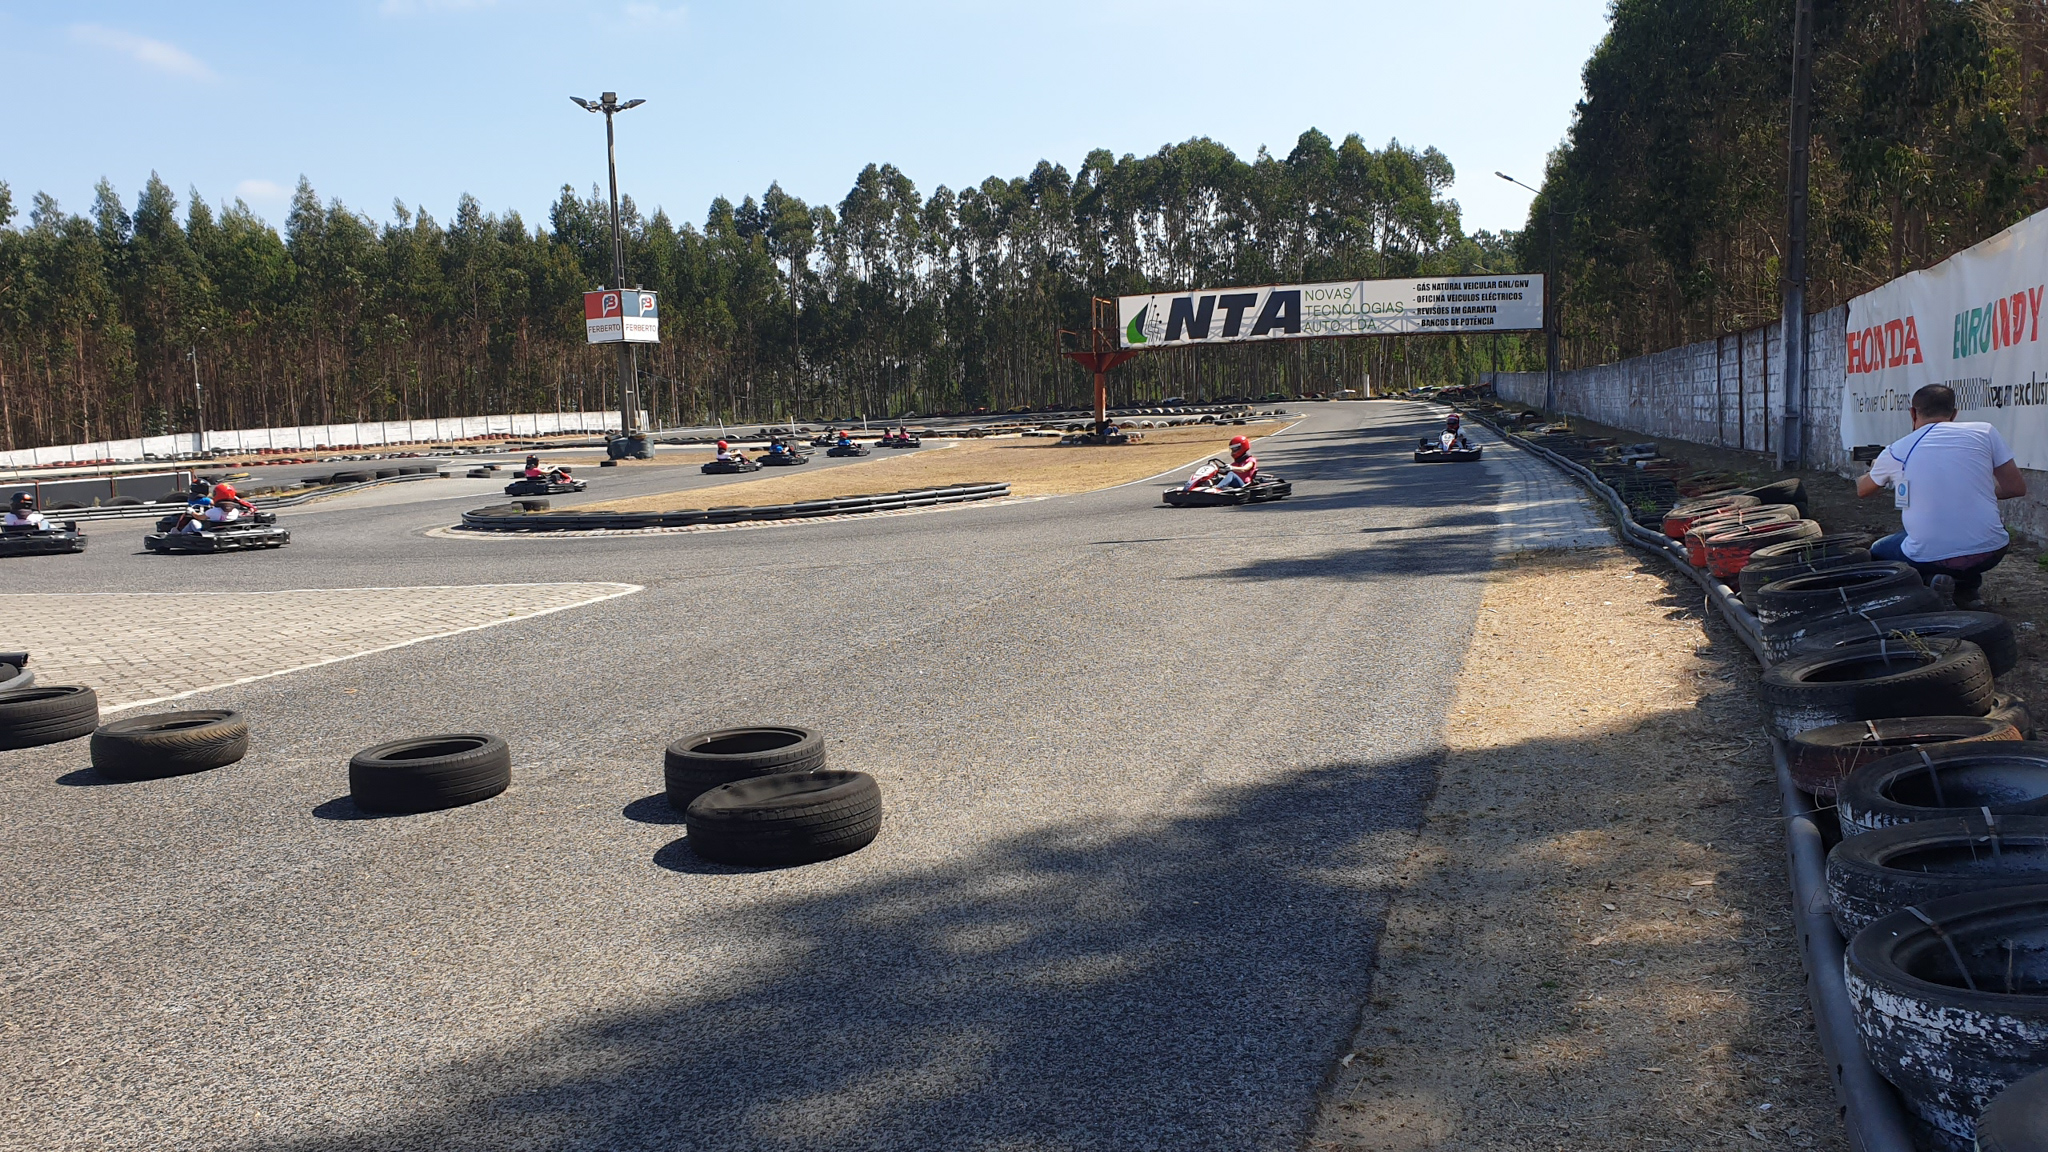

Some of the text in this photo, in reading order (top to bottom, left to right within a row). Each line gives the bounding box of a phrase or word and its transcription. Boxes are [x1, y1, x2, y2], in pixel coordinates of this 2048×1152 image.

[1416, 280, 1529, 291] GÁS NATURAL VEICULAR GNL/GNV
[1304, 287, 1352, 301] NOVAS
[1416, 295, 1446, 303] OFICINA
[1481, 292, 1523, 301] ELÉCTRICOS
[1304, 301, 1404, 317] TECNOLOGIAS
[1416, 305, 1497, 315] REVISÕES EM GARANTIA
[1164, 290, 1301, 341] NTA
[1421, 316, 1494, 327] BANCOS DE POTÊNCIA
[588, 323, 620, 333] FERBERTO
[625, 323, 656, 332] FERBERTO
[1846, 316, 1924, 374] HONDA
[1852, 392, 1864, 412] The
[1880, 388, 1888, 412] of
[1889, 388, 1911, 412] Dreams
